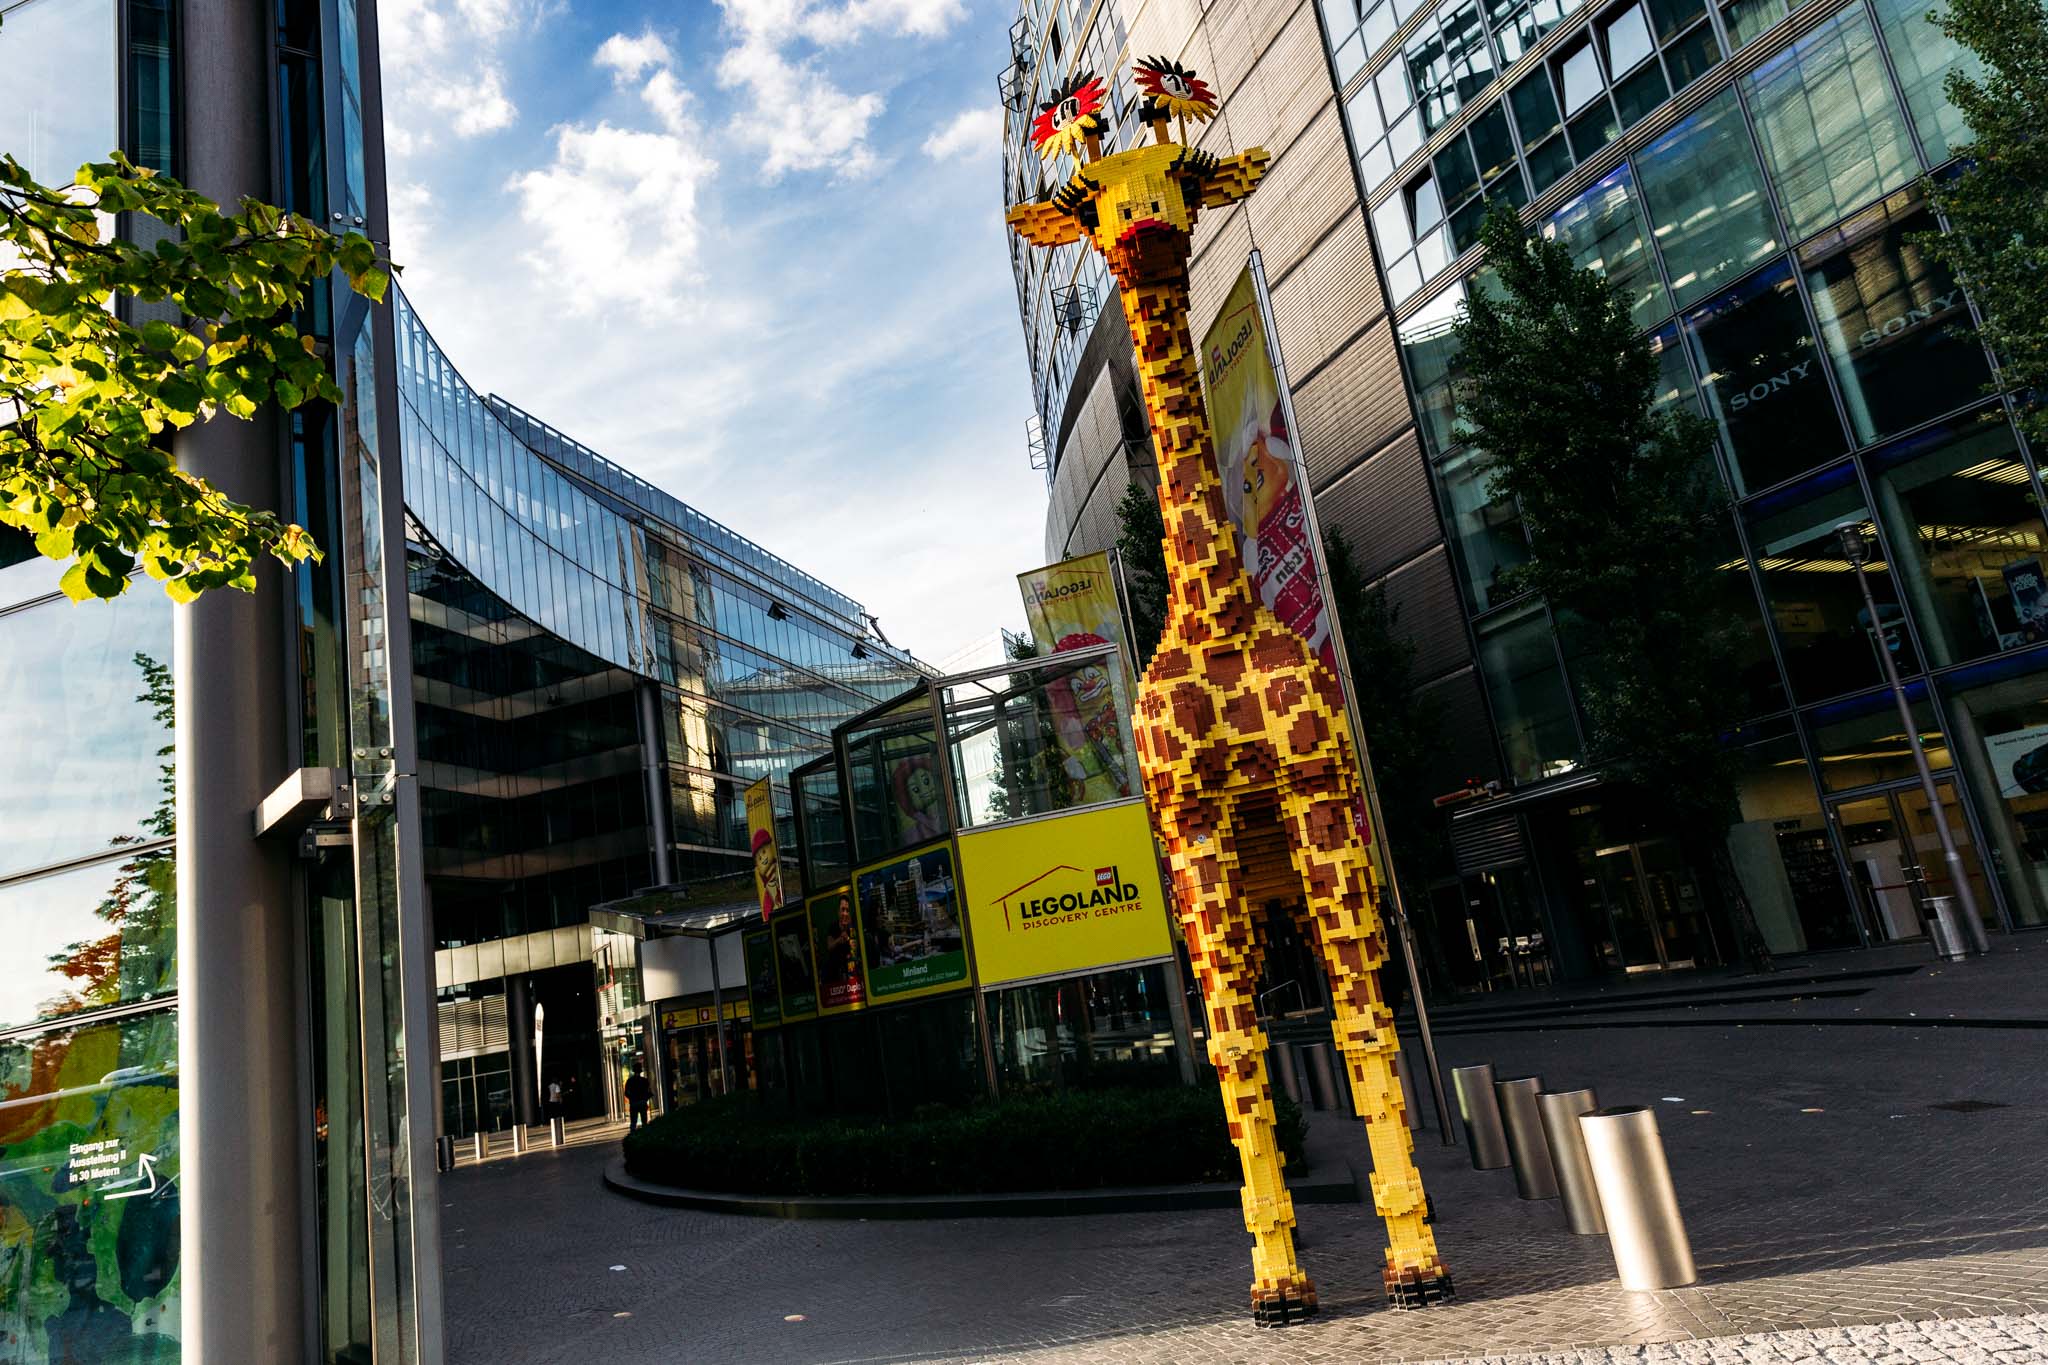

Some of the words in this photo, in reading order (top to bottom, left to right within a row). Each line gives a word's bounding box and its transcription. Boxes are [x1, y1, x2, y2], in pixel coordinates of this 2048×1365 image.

[1859, 289, 1960, 349] SONY
[1730, 359, 1812, 412] SONY
[1097, 872, 1112, 881] LEGO
[1020, 866, 1139, 919] LEGOLAND
[1023, 911, 1089, 930] DISCOVERY
[1094, 902, 1143, 918] CENTRE
[69, 1142, 105, 1154] Eingang
[105, 1139, 120, 1149] zur
[69, 1152, 120, 1168] Ausstellung
[69, 1173, 78, 1183] in
[79, 1170, 90, 1181] 30
[91, 1167, 121, 1179] Metern
